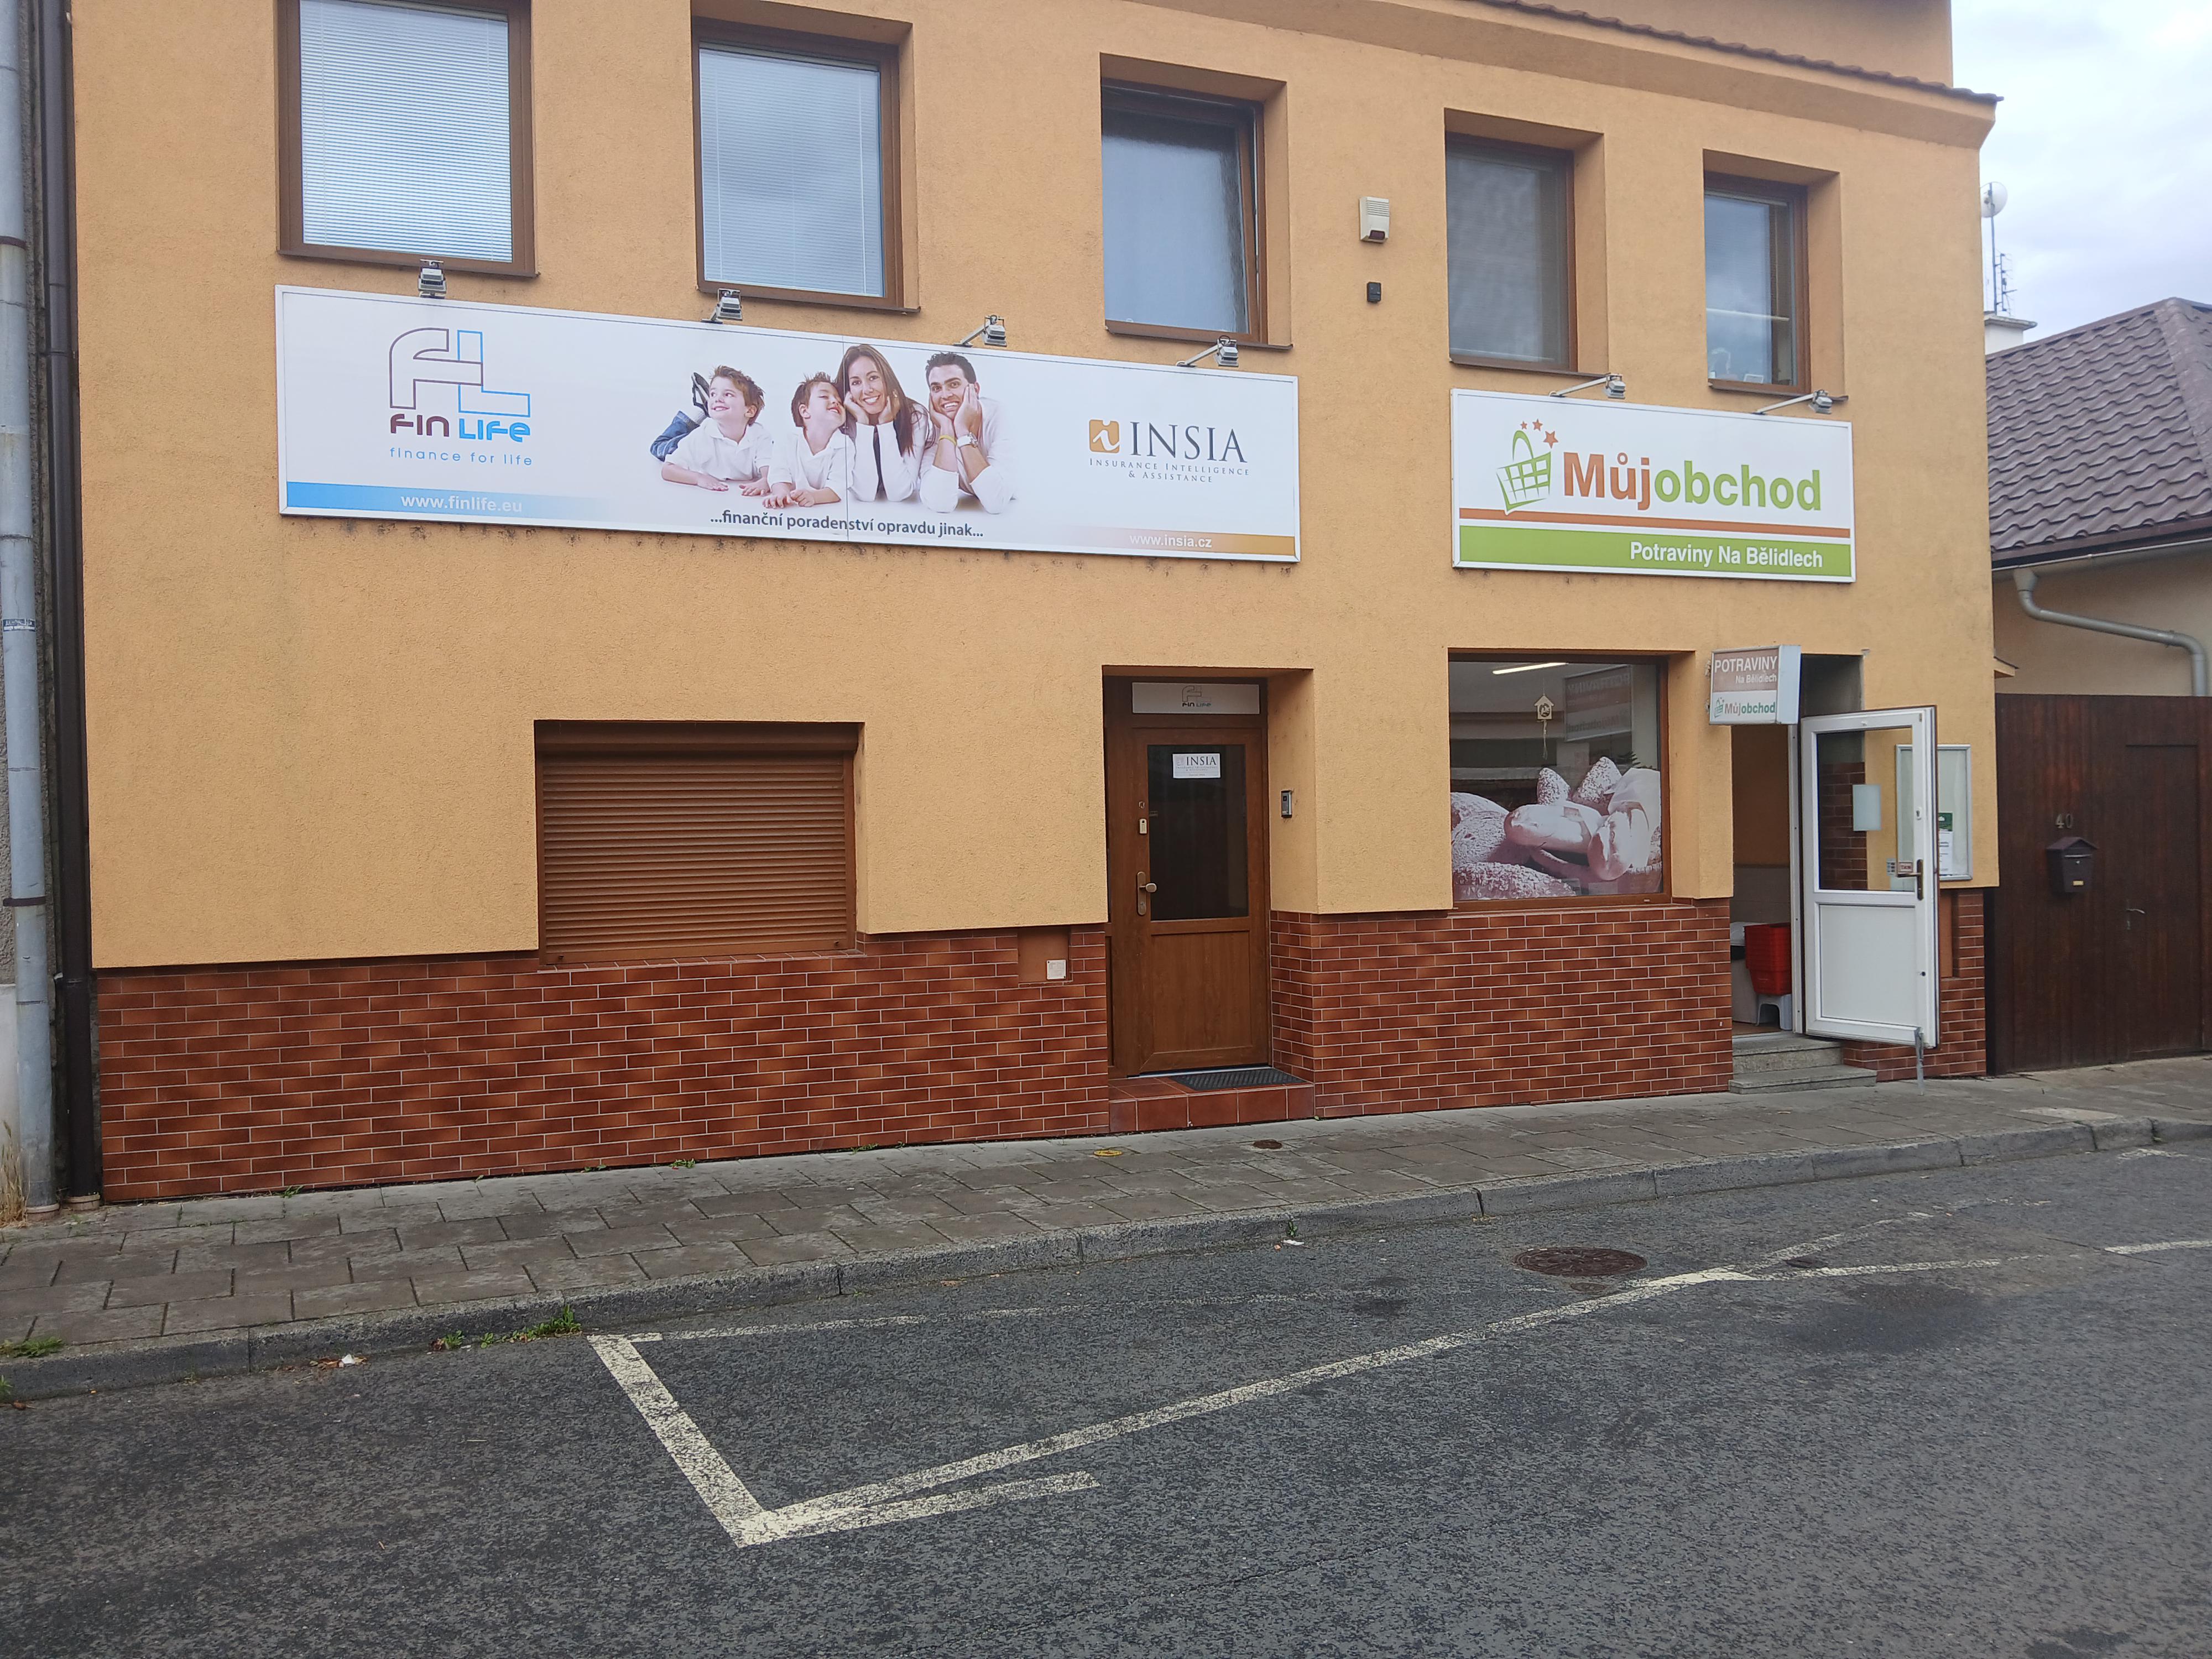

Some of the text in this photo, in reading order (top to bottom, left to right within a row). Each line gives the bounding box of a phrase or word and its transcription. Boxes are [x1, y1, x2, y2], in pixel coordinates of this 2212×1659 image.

[1130, 421, 1248, 463] INSIA
[390, 447, 532, 466] finance for life
[1128, 470, 1136, 478] &
[1563, 451, 1821, 510] Můjobchod
[400, 495, 523, 512] www.finlife.eu
[787, 515, 874, 531] poradenství
[877, 520, 936, 535] opravdu
[1129, 534, 1213, 548] www.insia.cz
[1630, 541, 1823, 568] Potraviny Na Bělidlech
[1714, 656, 1778, 673] POTRAVINY
[1735, 675, 1744, 684] Na
[1186, 756, 1217, 766] INSIA
[2056, 813, 2074, 828] 40
